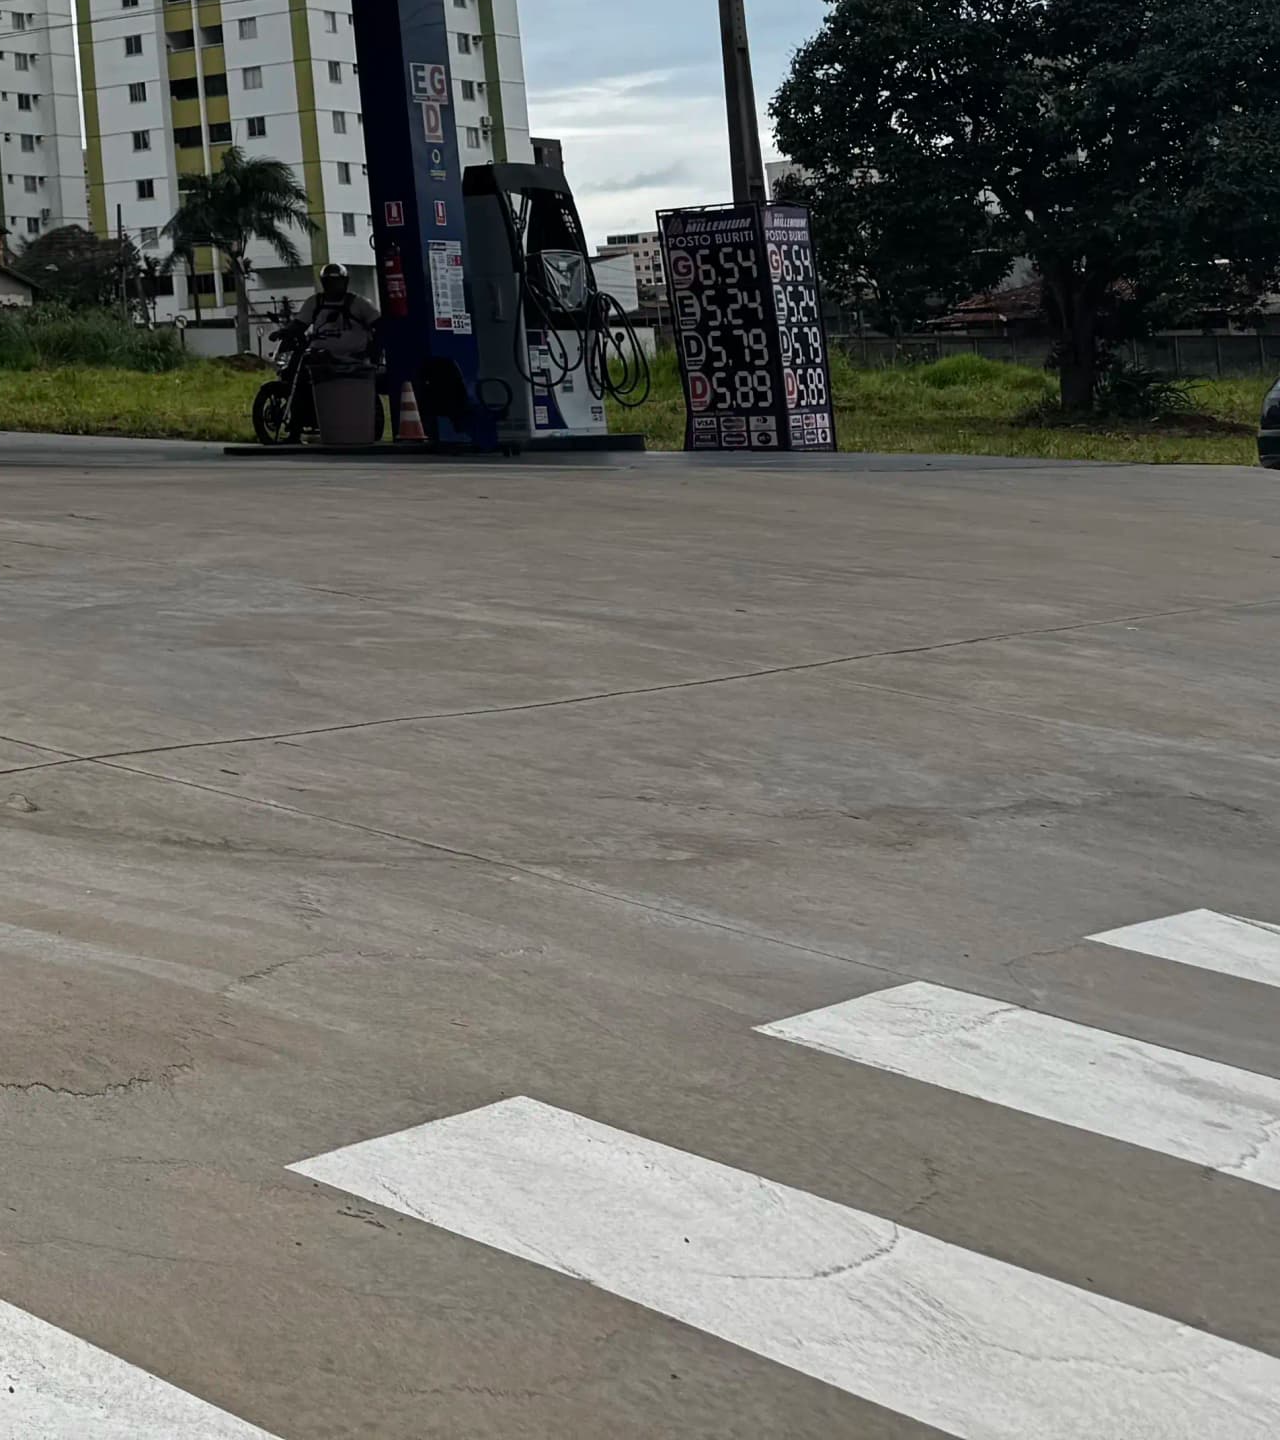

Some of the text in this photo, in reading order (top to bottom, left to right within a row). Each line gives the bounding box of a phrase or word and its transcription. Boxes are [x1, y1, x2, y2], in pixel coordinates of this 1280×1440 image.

[685, 218, 752, 233] MILLENIUM
[765, 230, 788, 242] POSTO
[668, 230, 754, 248] POSTO BURITI
[672, 255, 692, 277] G
[678, 296, 696, 319] E
[685, 334, 702, 359] D
[690, 375, 709, 400] D
